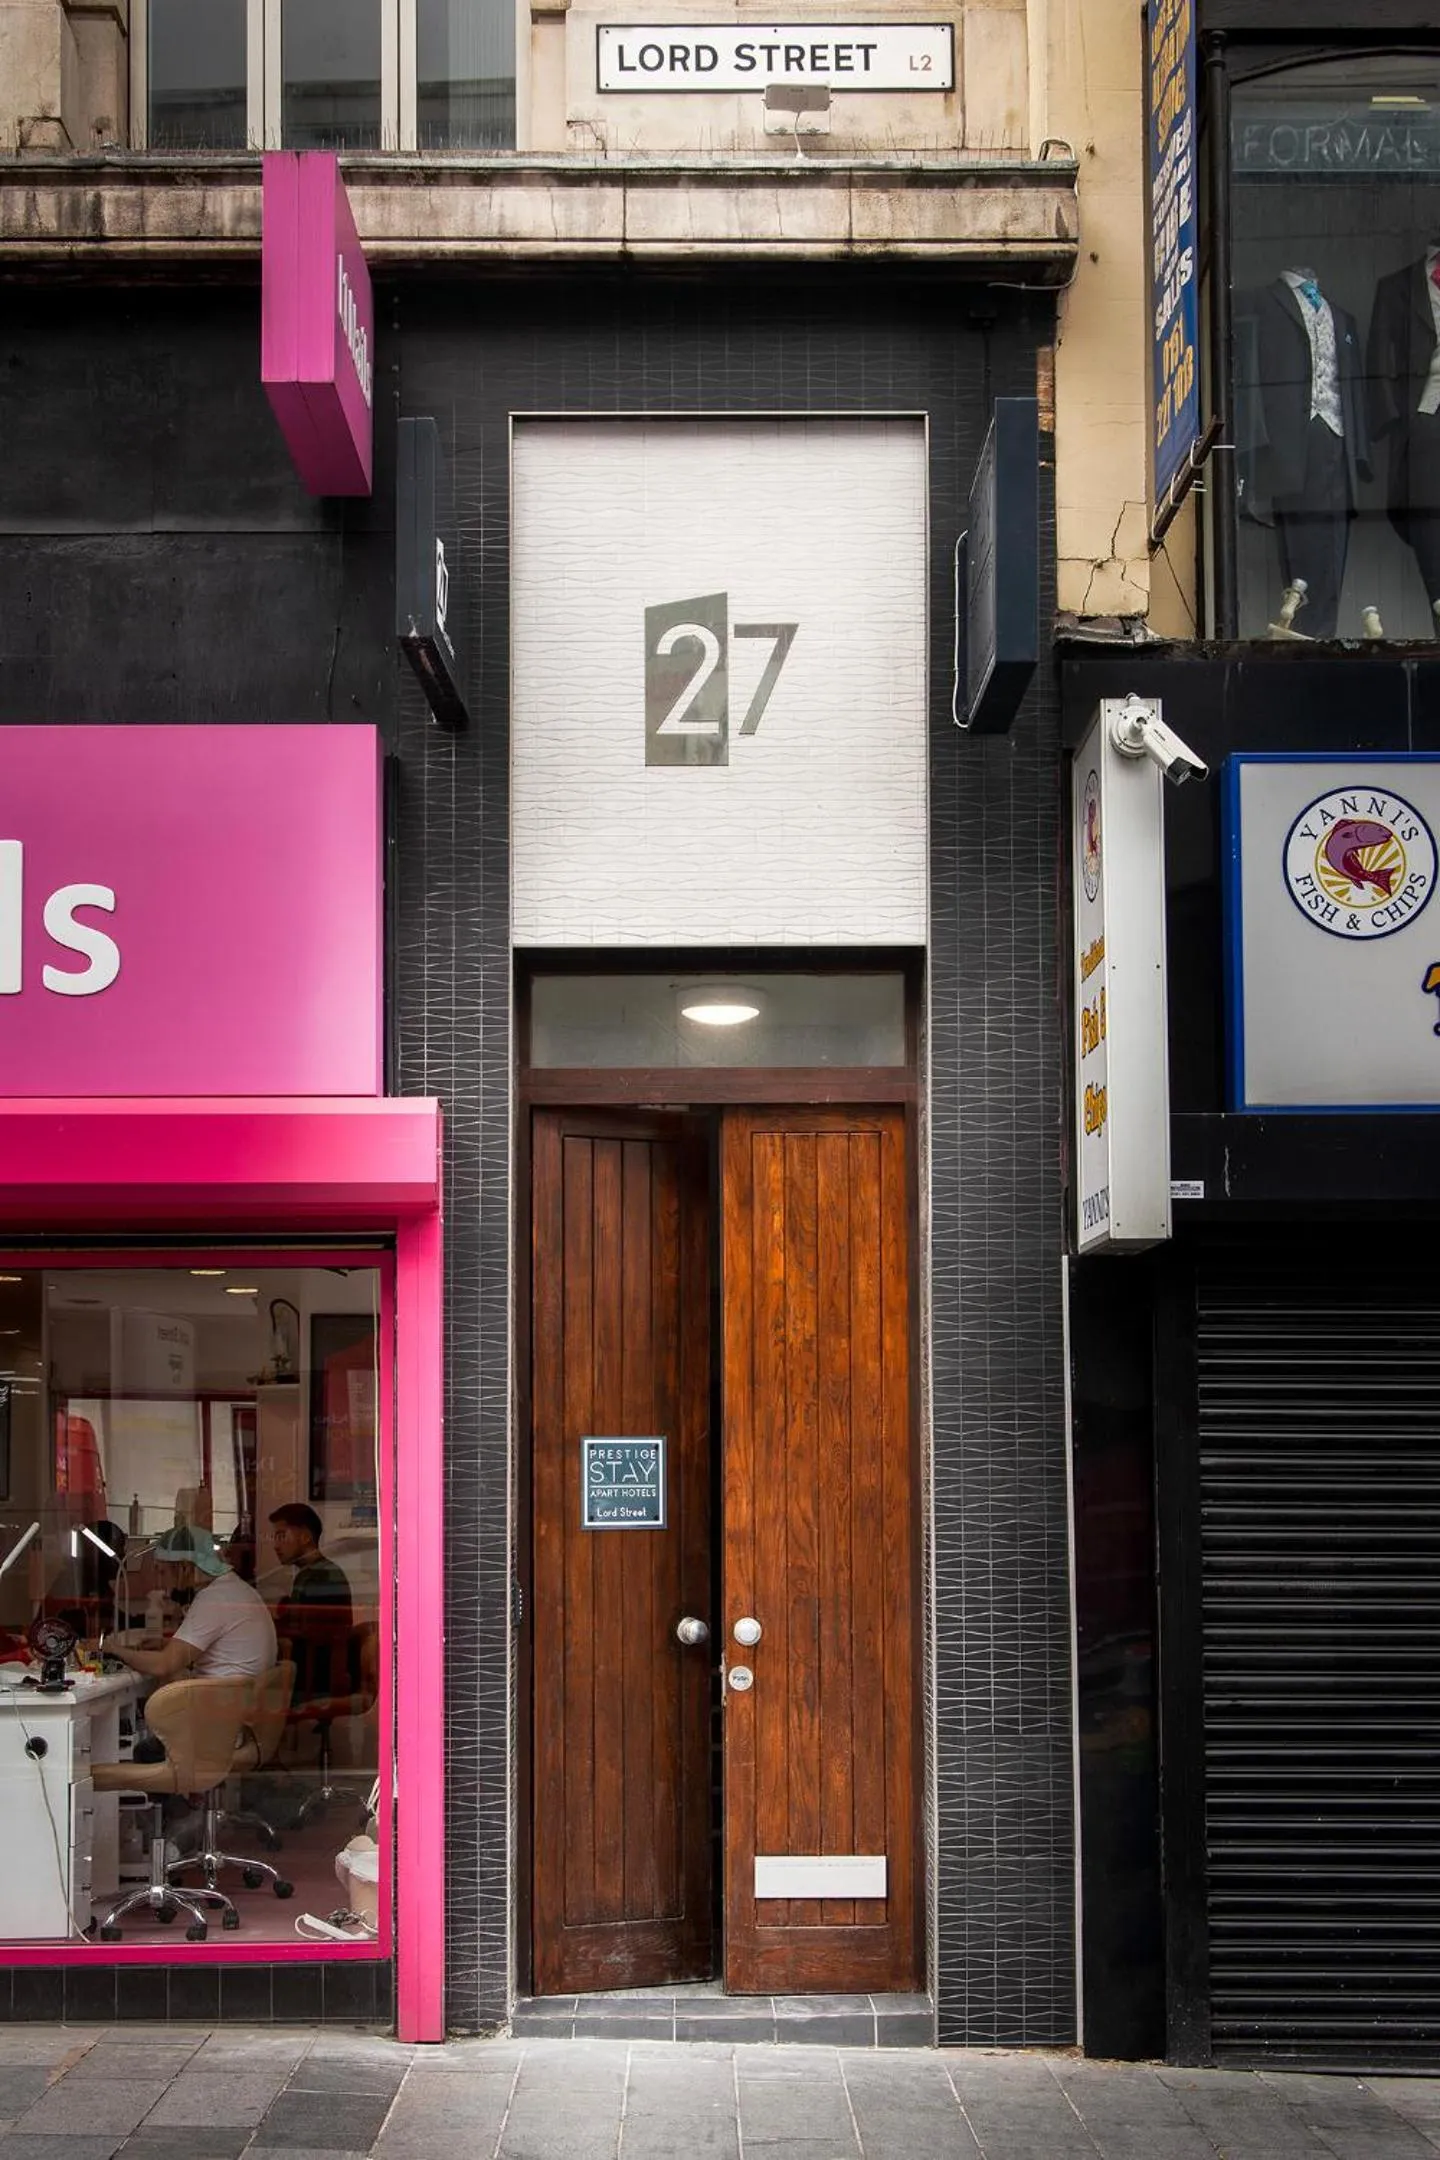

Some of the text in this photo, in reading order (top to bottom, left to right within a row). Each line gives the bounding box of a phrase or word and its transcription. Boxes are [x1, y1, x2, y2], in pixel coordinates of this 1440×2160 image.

[617, 43, 932, 72] LORD STREET L2
[1243, 123, 1429, 166] FORMAL
[656, 622, 799, 735] 27
[1300, 796, 1419, 842] YANNI'S
[1295, 873, 1427, 931] FISH & CHIPS
[589, 1449, 656, 1460] PRESTIGE
[589, 1461, 656, 1483] STAY
[590, 1488, 657, 1498] APART HOTELS
[597, 1506, 647, 1518] Lord Street
